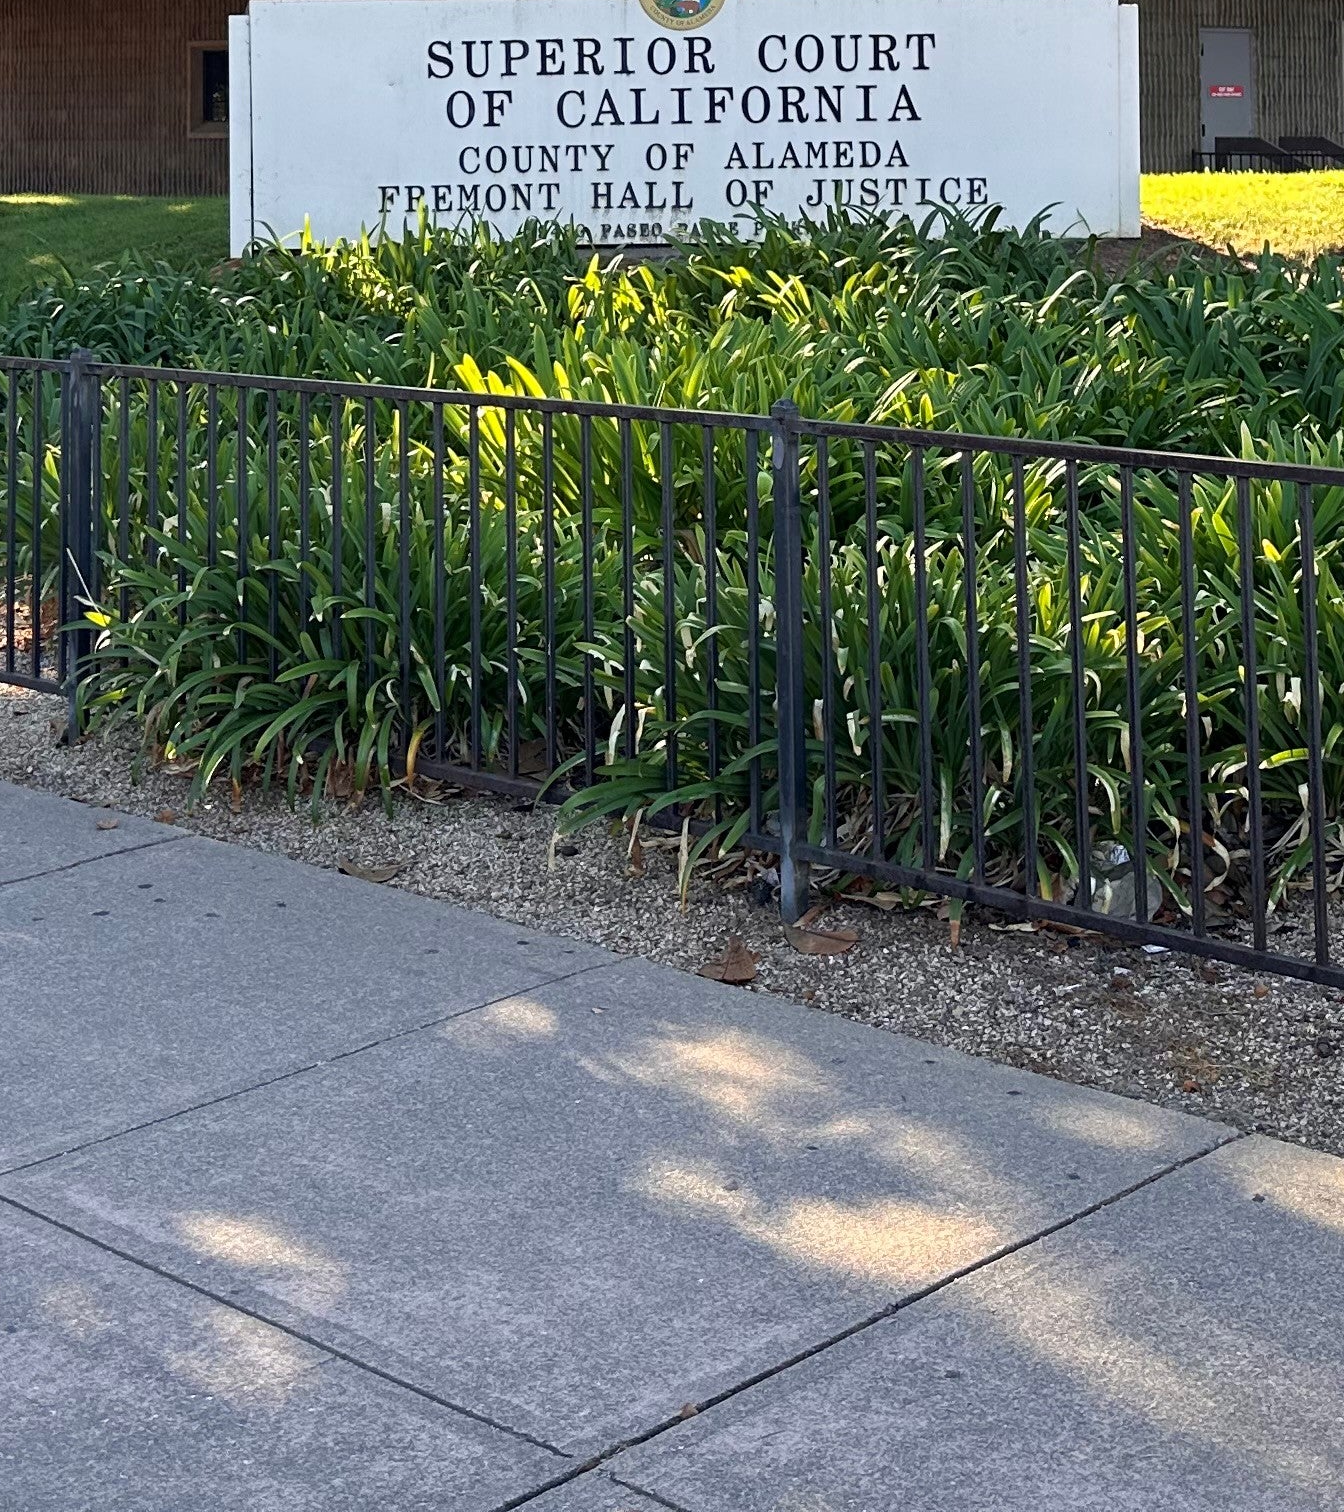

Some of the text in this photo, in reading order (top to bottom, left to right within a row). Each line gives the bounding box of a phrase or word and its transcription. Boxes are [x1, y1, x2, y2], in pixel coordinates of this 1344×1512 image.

[427, 33, 937, 79] SUPERIOR COURT
[446, 84, 922, 129] OF CALIFORNIA
[458, 140, 910, 174] COUNTY OF ALAMEDA
[377, 176, 989, 214] FREMONT HALL OF JUSTICE
[599, 223, 663, 239] PASEO
